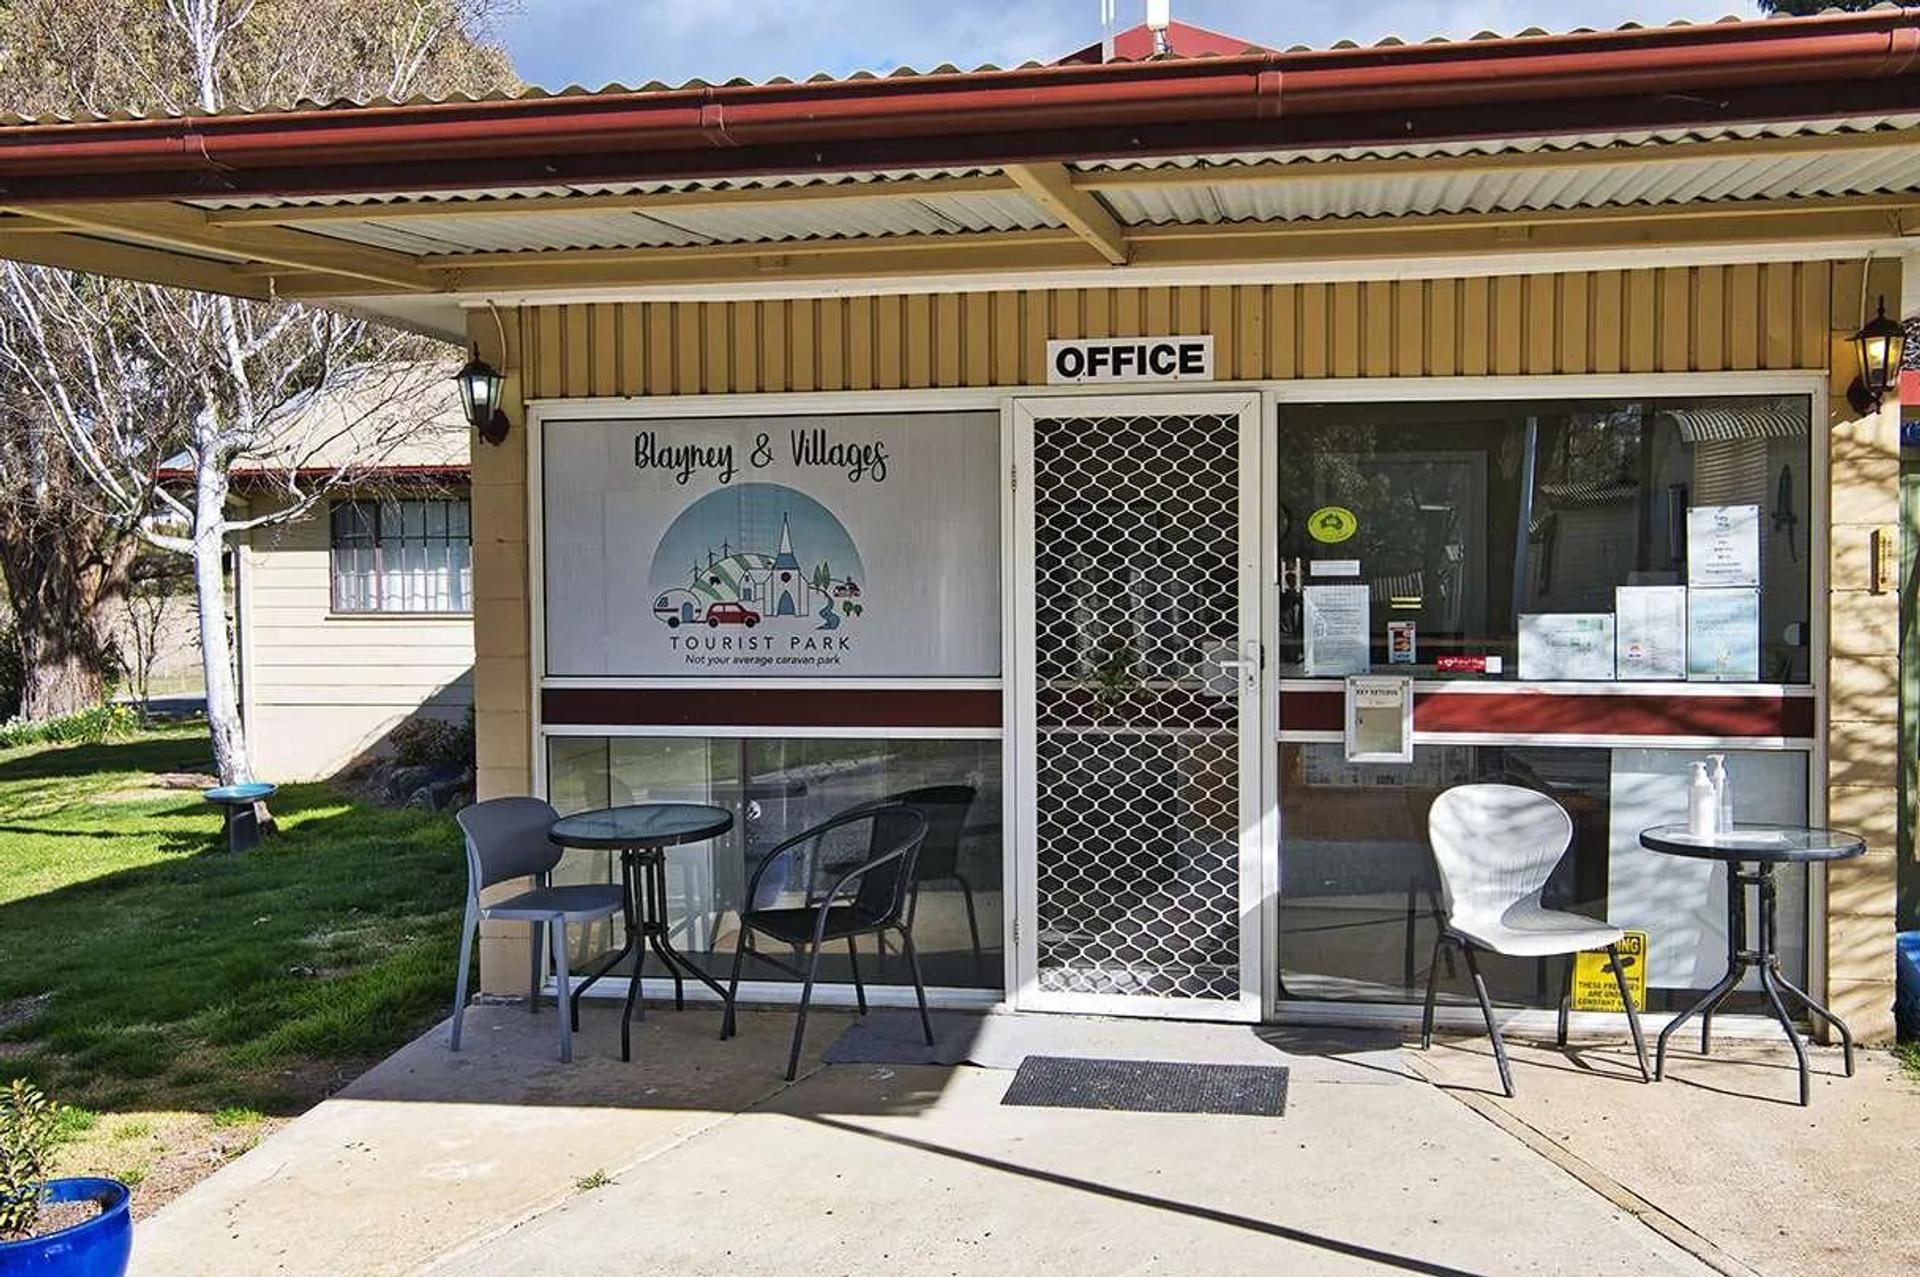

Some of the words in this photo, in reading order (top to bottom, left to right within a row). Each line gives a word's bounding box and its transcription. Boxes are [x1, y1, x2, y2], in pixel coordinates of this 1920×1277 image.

[1055, 343, 1205, 378] OFFICE
[634, 431, 738, 485] Blayney
[750, 433, 774, 468] &
[791, 429, 889, 482] Villages
[670, 636, 774, 650] TOURIST
[791, 636, 850, 650] PARK
[685, 654, 706, 664] Not
[707, 656, 731, 666] your
[733, 656, 774, 667] average
[776, 656, 815, 665] caravan
[816, 653, 840, 667] park
[1578, 981, 1602, 990] THESE
